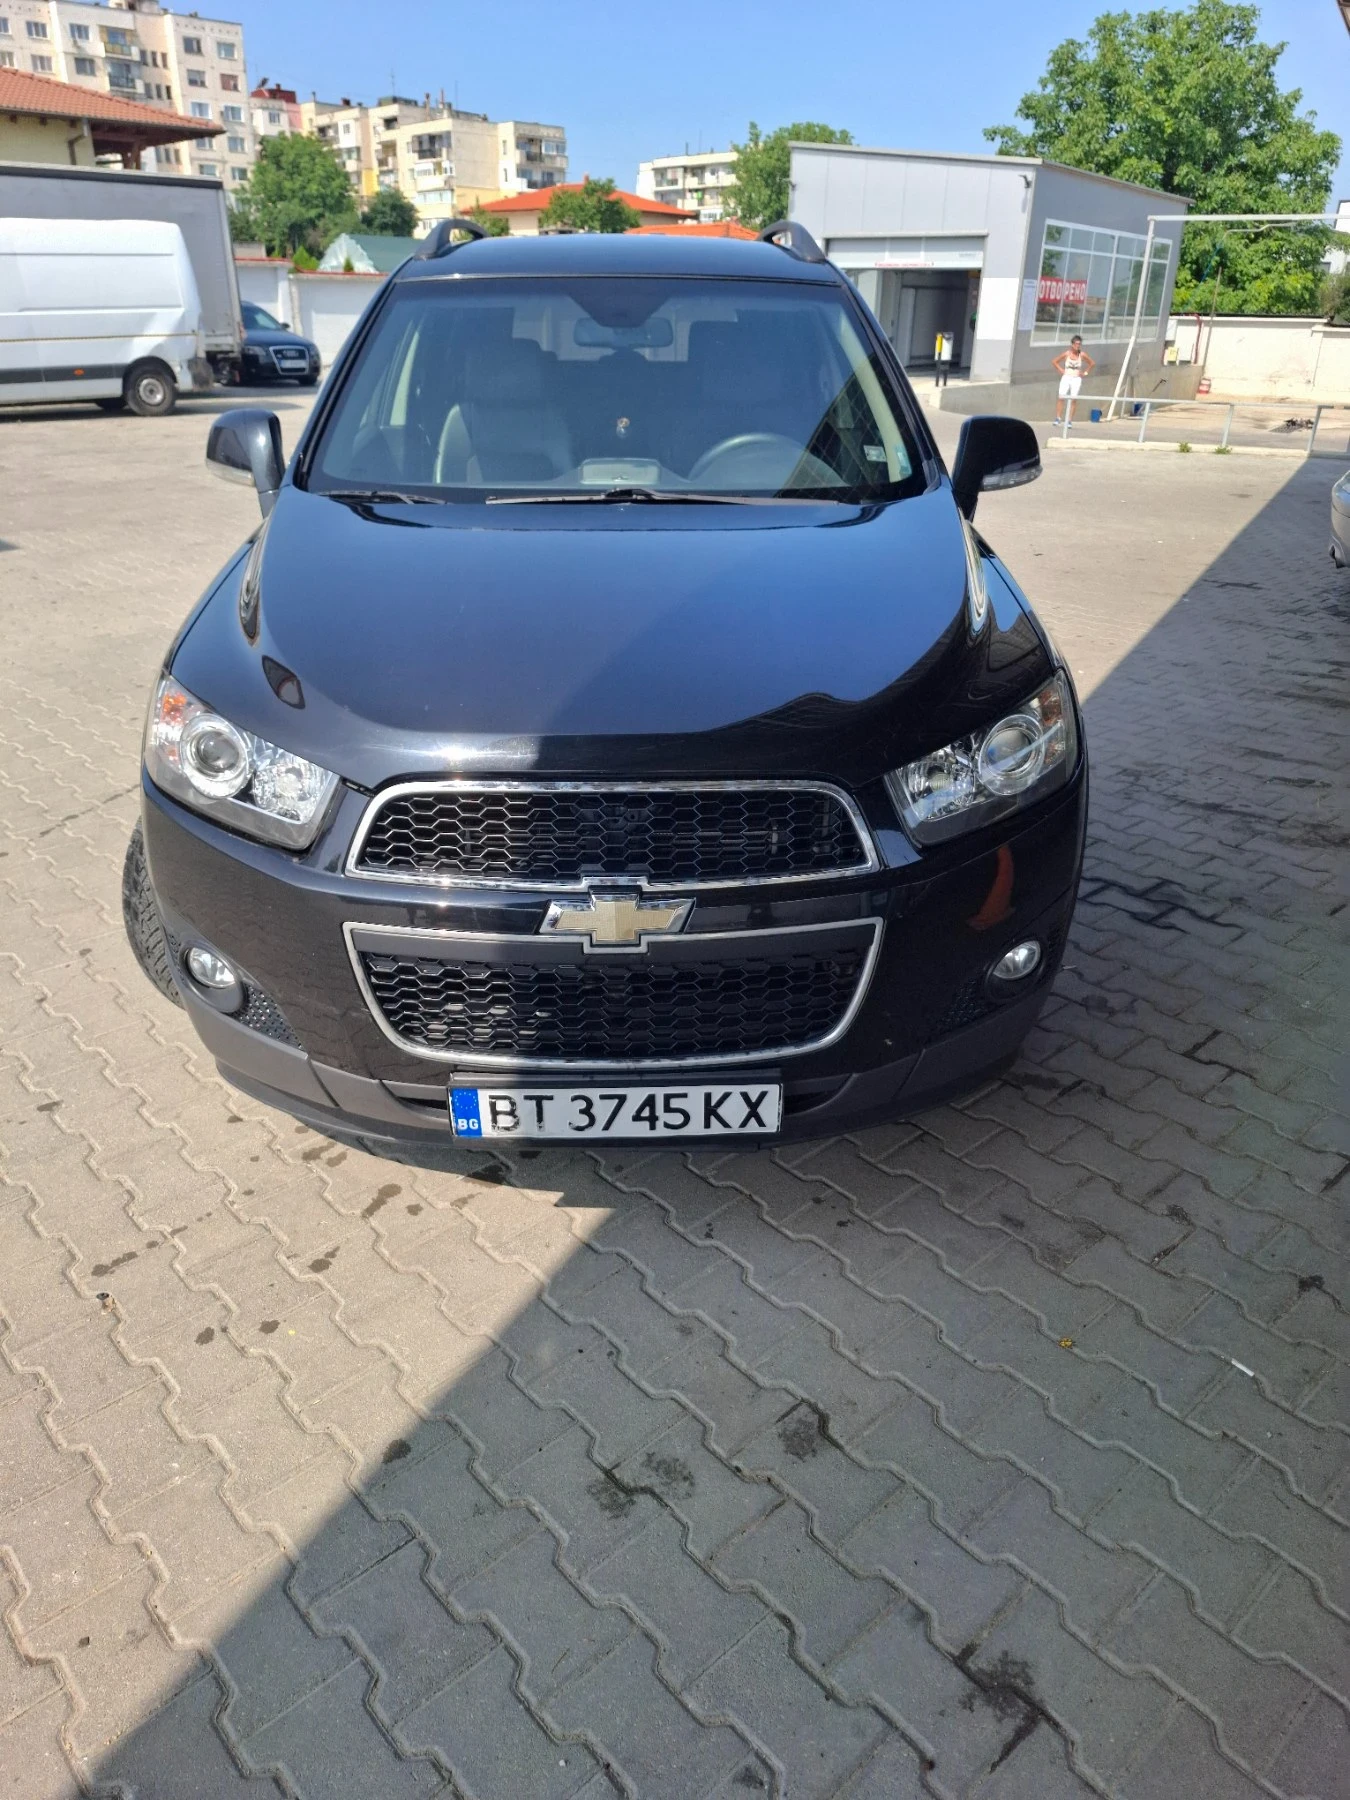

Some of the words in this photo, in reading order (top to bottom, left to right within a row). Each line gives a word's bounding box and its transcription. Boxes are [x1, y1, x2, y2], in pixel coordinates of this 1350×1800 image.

[1038, 279, 1086, 301] ОТВОРЕНО
[488, 1094, 554, 1132] BT
[568, 1093, 691, 1131] 3745
[703, 1090, 769, 1129] KX
[457, 1118, 479, 1130] BG
